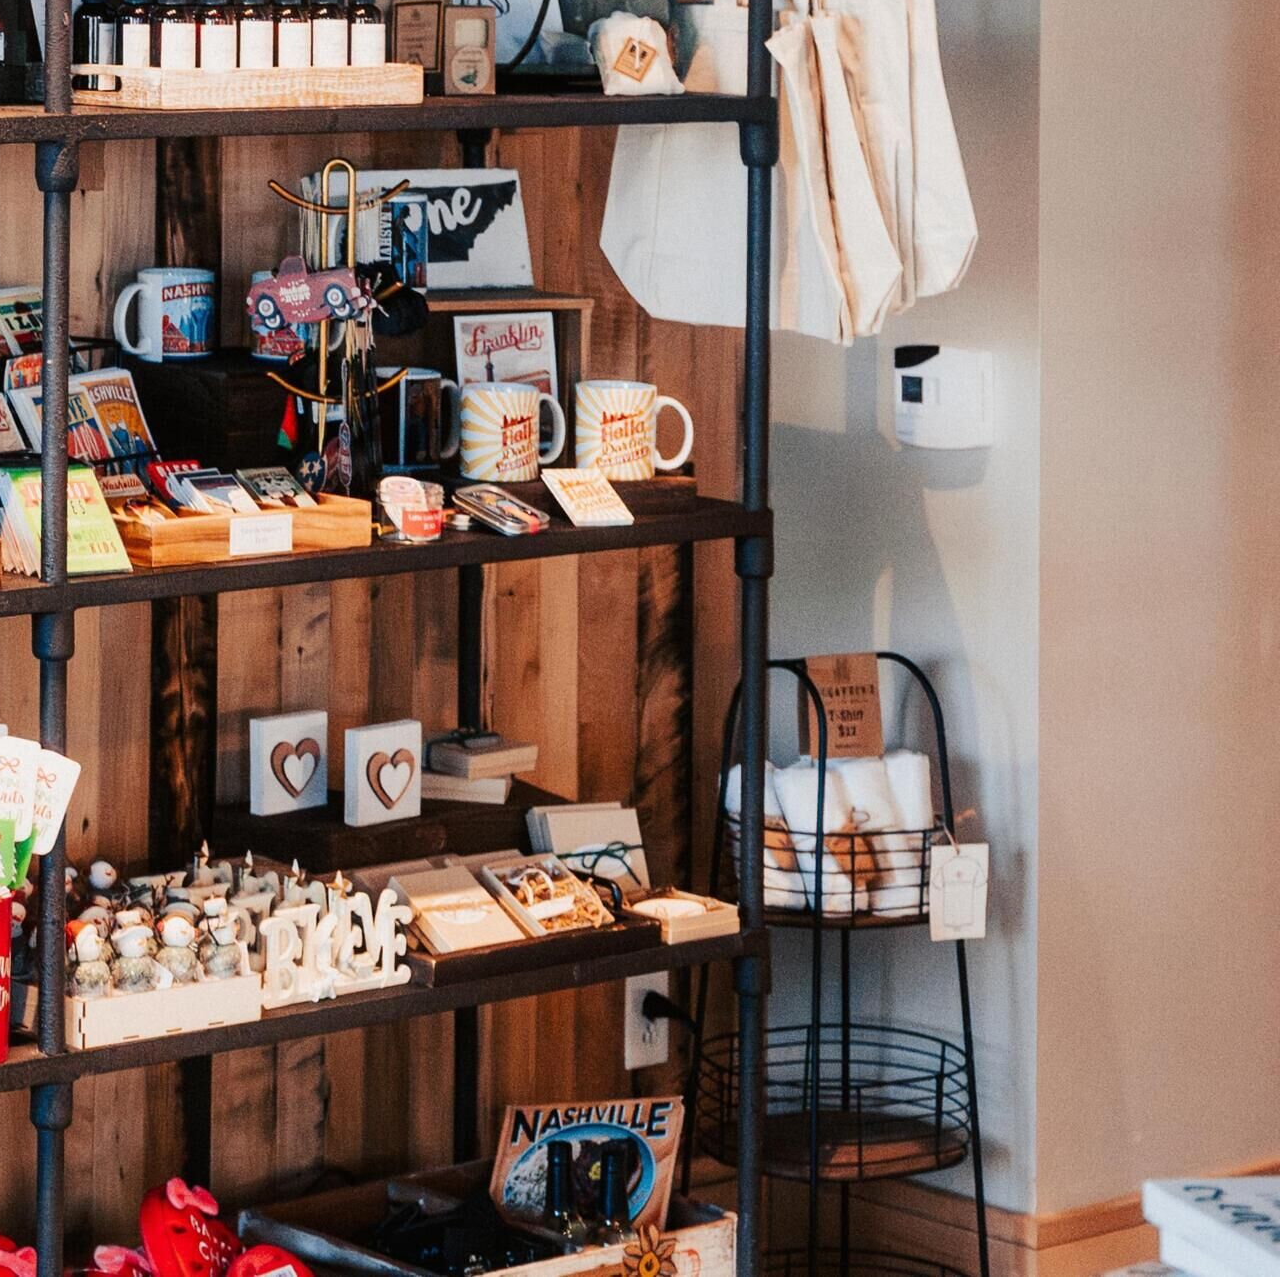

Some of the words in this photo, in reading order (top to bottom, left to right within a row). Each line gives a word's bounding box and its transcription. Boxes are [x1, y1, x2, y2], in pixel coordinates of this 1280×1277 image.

[464, 322, 544, 357] Franklin
[101, 478, 141, 492] Nashville
[510, 1100, 674, 1144] NASHVILLE
